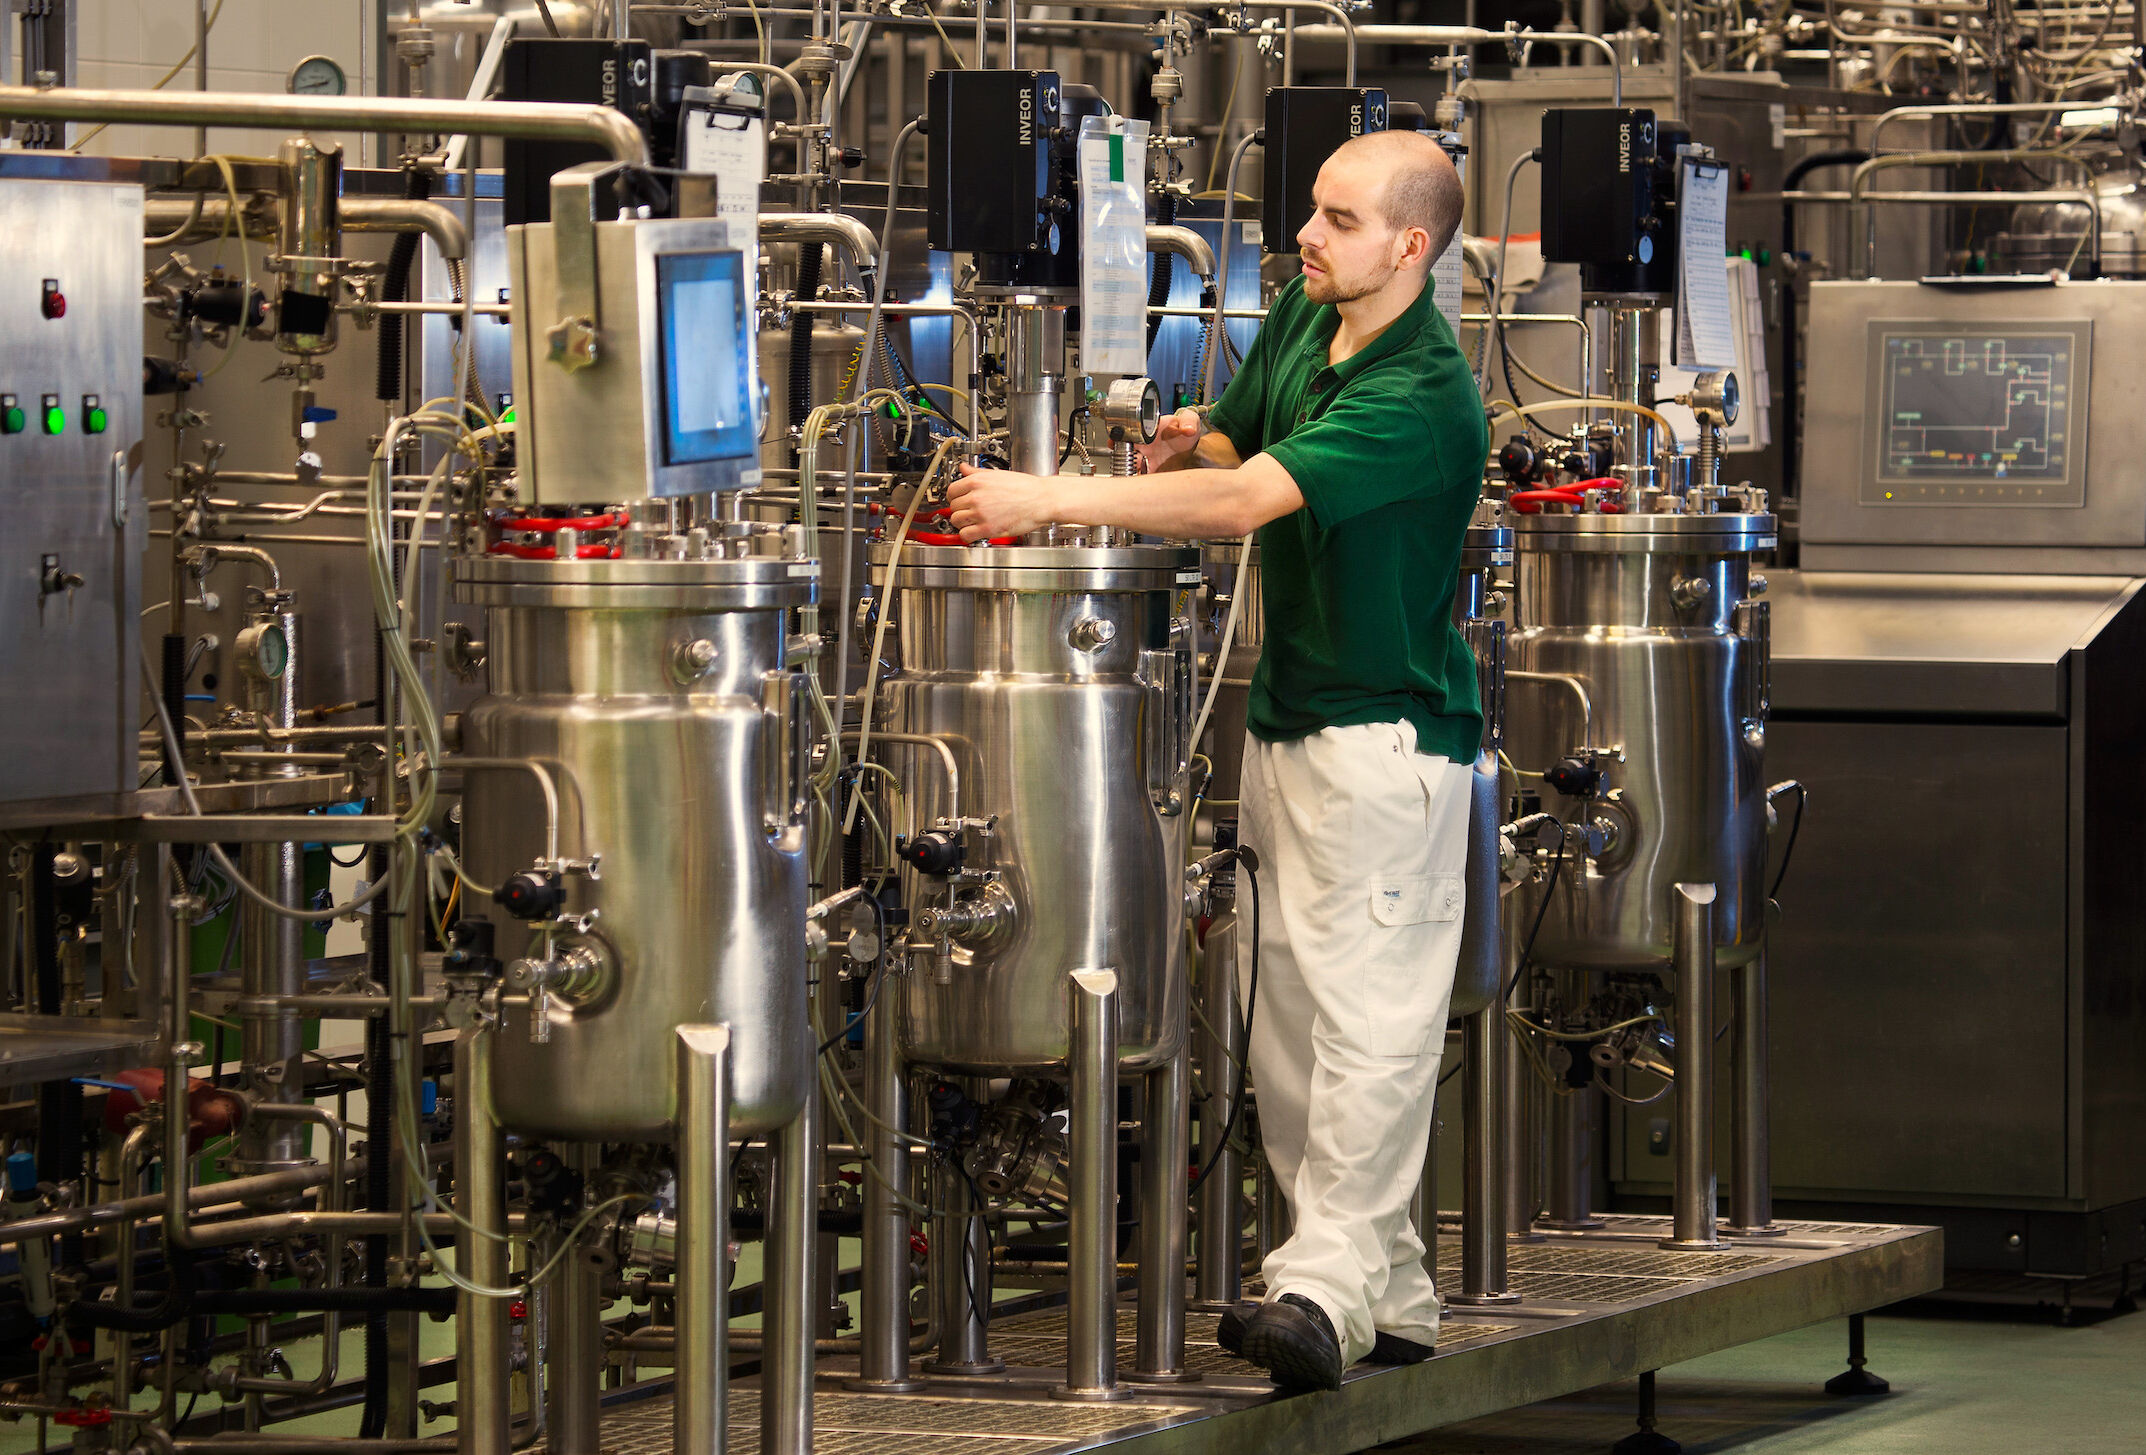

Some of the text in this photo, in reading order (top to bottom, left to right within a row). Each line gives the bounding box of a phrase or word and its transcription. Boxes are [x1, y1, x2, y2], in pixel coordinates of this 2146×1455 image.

[602, 59, 616, 105] VEOR
[1019, 88, 1031, 146] INVEOR
[1350, 104, 1361, 138] EOR
[1620, 123, 1630, 172] INVEOR
